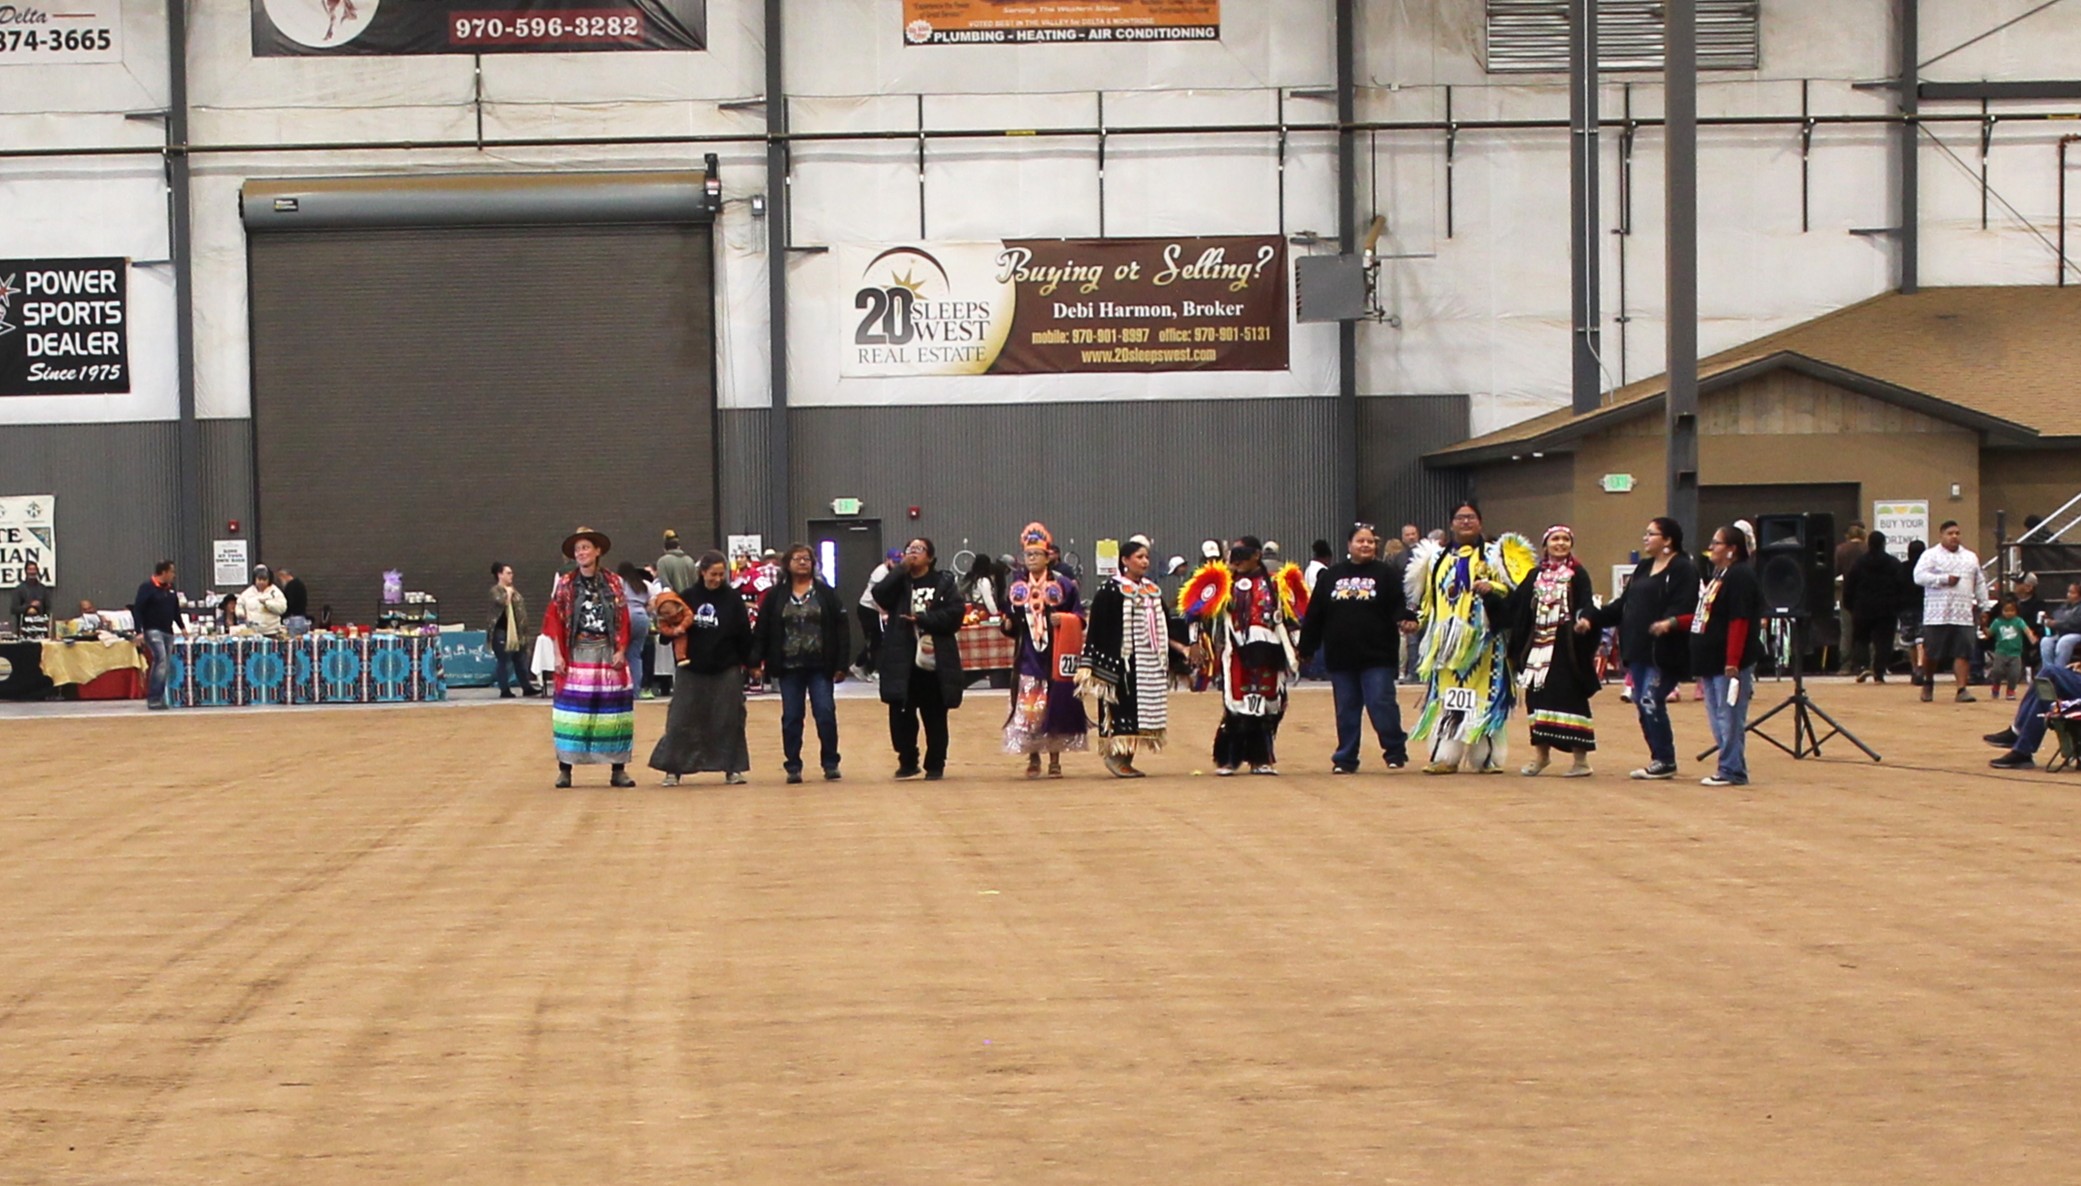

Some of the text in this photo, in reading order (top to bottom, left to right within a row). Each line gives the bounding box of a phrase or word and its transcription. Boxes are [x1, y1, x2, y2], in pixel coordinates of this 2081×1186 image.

[0, 5, 48, 24] Delta
[455, 16, 639, 38] 970-596-3282
[933, 30, 1005, 42] PLUMBING
[1016, 28, 1077, 41] HEATING
[1088, 28, 1113, 40] AIR
[1115, 26, 1216, 40] CONDITIONING
[995, 243, 1275, 296] Buying or Selling?
[25, 269, 117, 295] POWER
[22, 300, 123, 326] SPORTS
[854, 286, 991, 345] 20 SLEEPS
[1053, 300, 1244, 320] Debi Harmon, Broker
[914, 320, 991, 342] WEST
[1031, 325, 1271, 345] mobile: 970-901-8997 office: 970-901-5131
[26, 331, 120, 357] DEALER
[858, 345, 988, 364] REAL ESTATE
[1081, 346, 1217, 364] www.20sleepswest.com
[27, 362, 121, 382] Since 1975
[1880, 518, 1925, 529] BUY YOUR
[1447, 689, 1472, 709] 201
